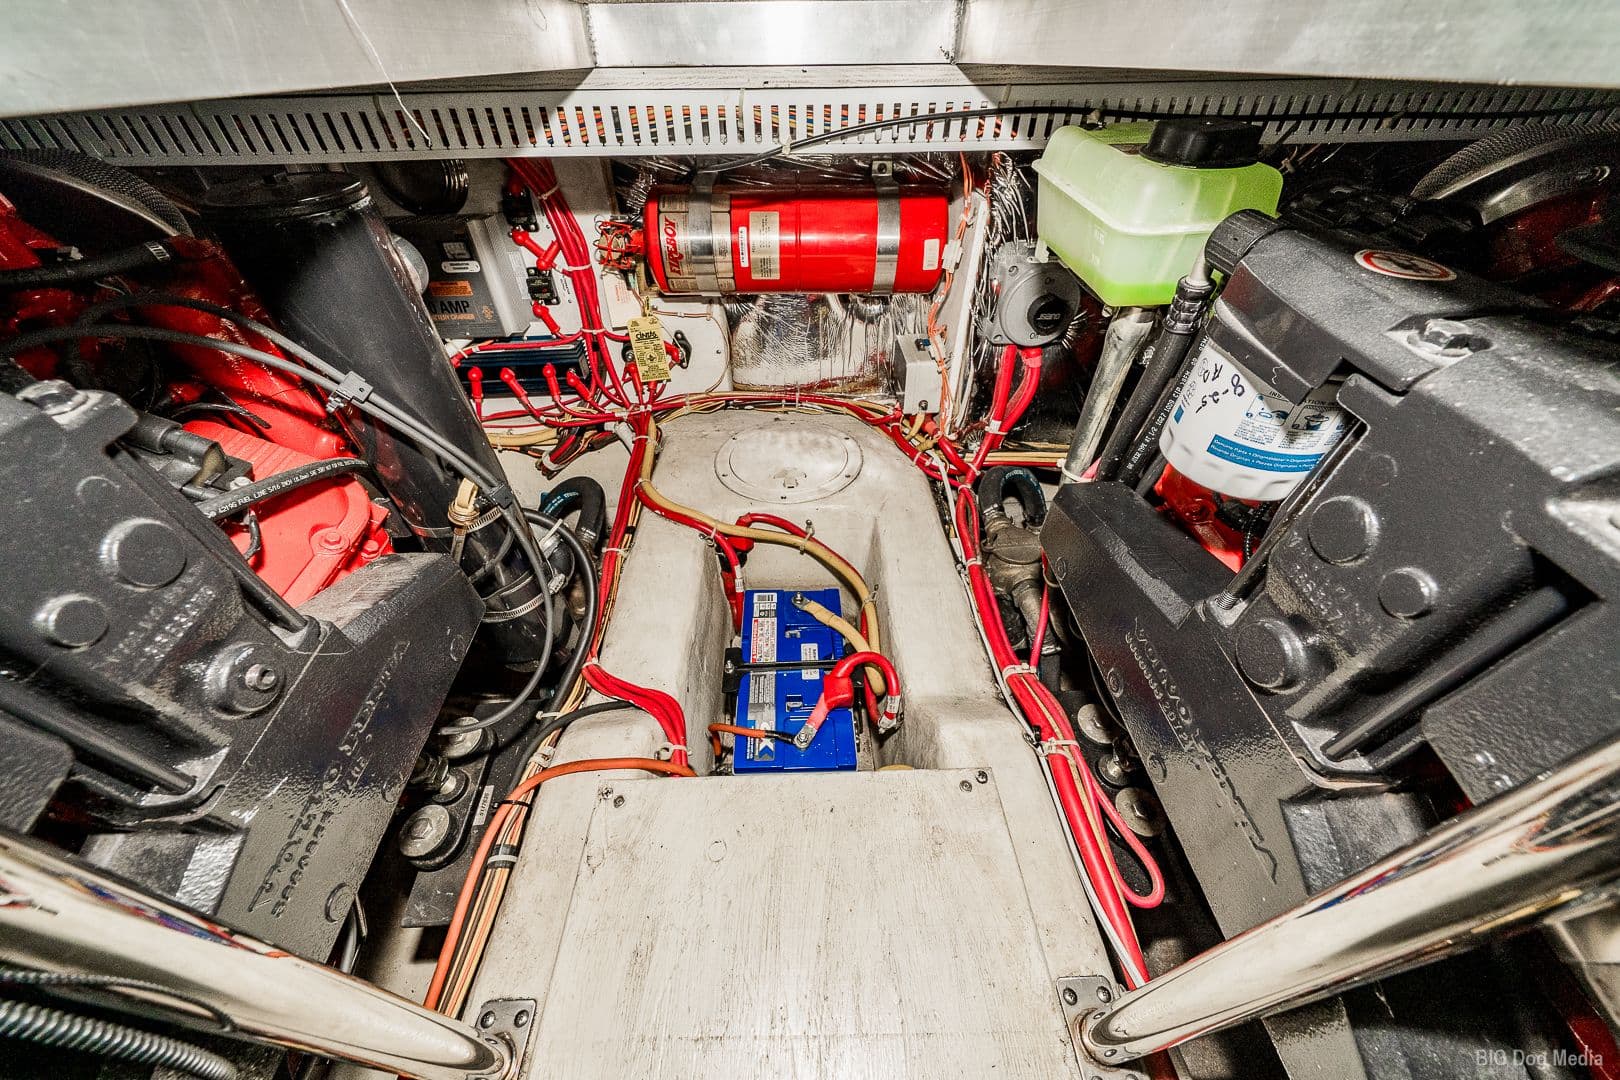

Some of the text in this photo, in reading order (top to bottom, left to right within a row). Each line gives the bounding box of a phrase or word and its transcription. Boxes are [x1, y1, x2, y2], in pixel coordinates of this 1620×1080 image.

[664, 216, 684, 276] FIREBOY
[441, 301, 470, 314] AMP
[635, 330, 659, 340] CINTAS
[238, 496, 254, 506] FUEL
[253, 489, 269, 499] LINE
